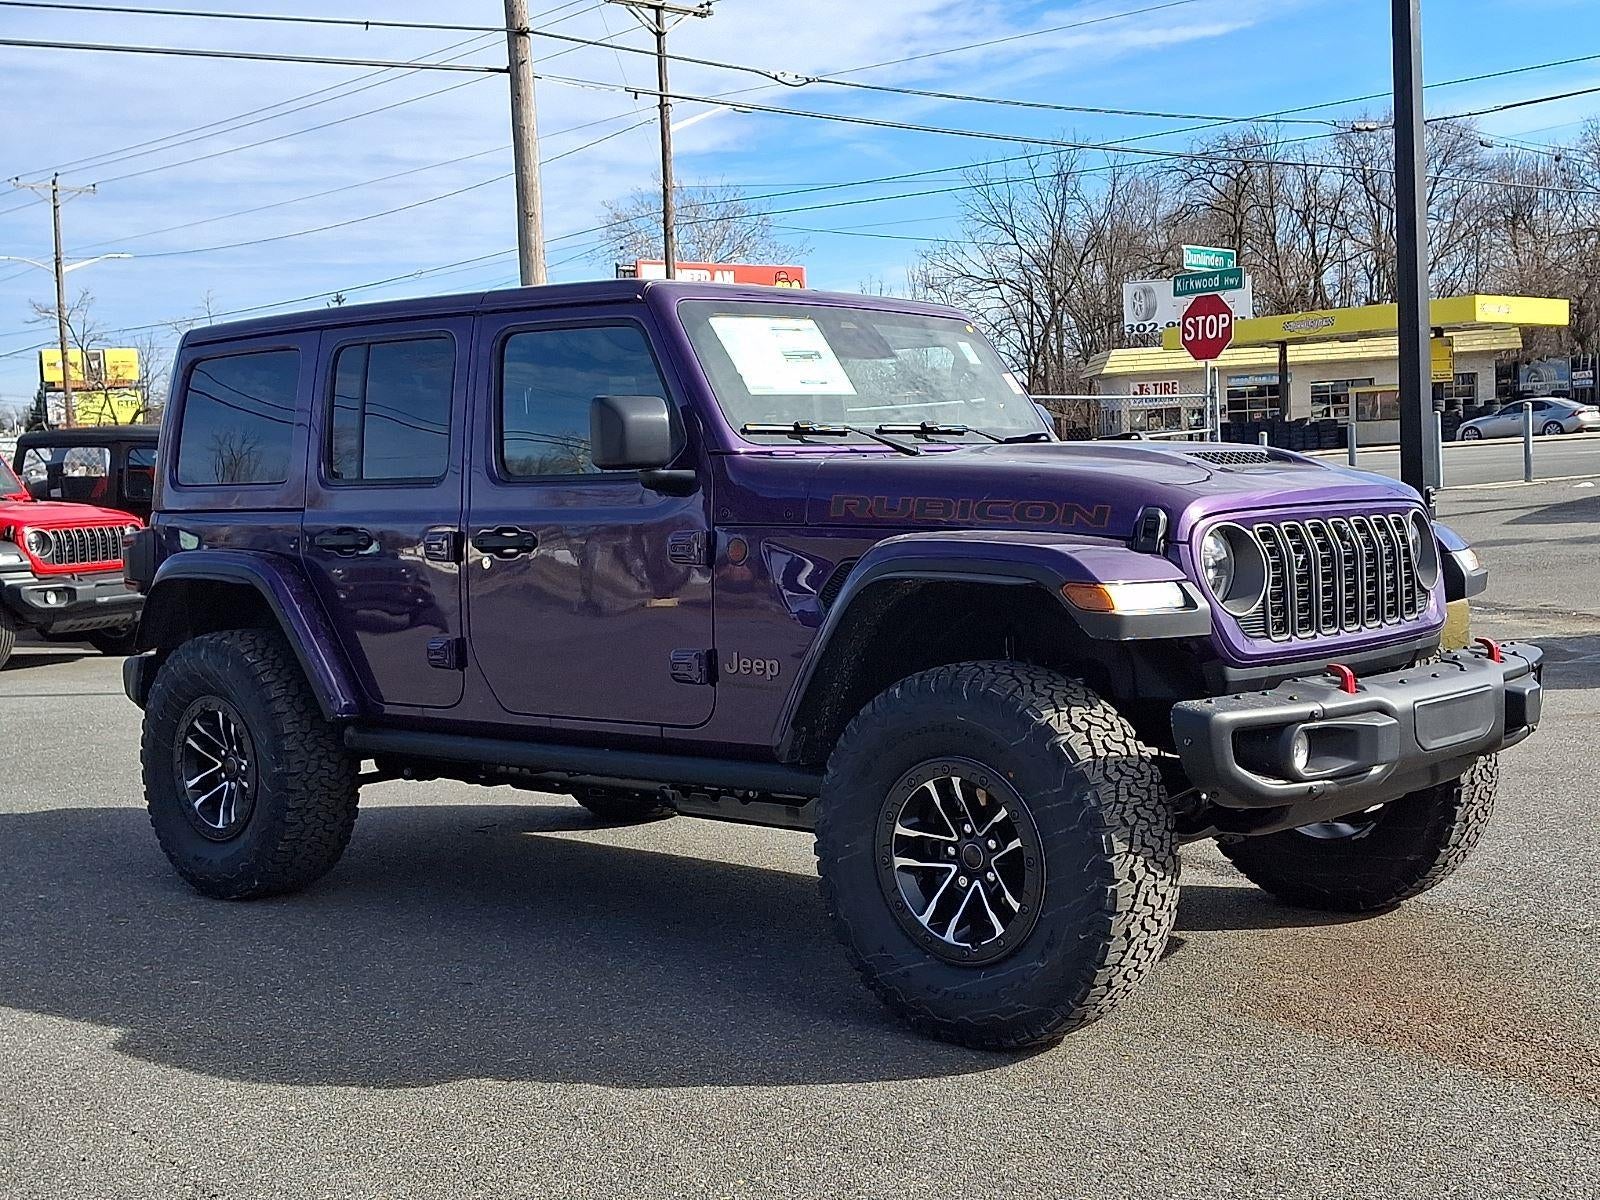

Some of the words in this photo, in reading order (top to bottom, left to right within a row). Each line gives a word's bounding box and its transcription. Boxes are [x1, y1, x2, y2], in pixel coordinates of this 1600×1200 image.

[1185, 250, 1224, 267] Dunlinden
[1176, 274, 1220, 291] Kirkwood
[1224, 276, 1240, 286] Hwy
[1183, 313, 1230, 341] STOP
[1153, 381, 1178, 396] TIRE
[829, 494, 1112, 528] RUBICON
[724, 651, 780, 681] Jeep
